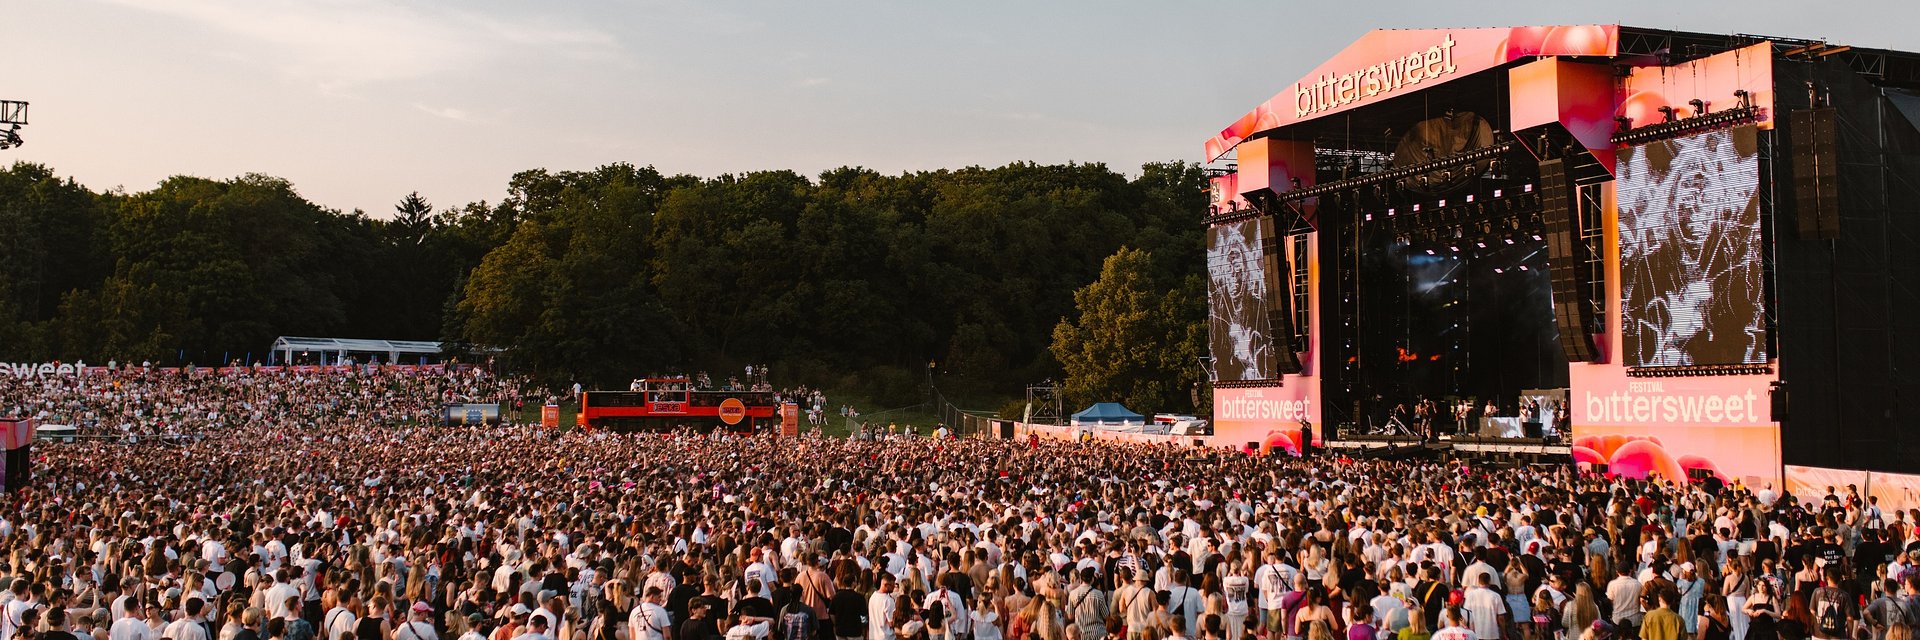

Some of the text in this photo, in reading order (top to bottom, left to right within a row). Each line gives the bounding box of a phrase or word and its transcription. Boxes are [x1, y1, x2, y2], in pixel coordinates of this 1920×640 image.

[1295, 33, 1457, 118] bittersweet
[1630, 381, 1664, 393] FESTIVAL
[1222, 395, 1311, 420] bittersweet
[1586, 388, 1758, 423] bittersweet
